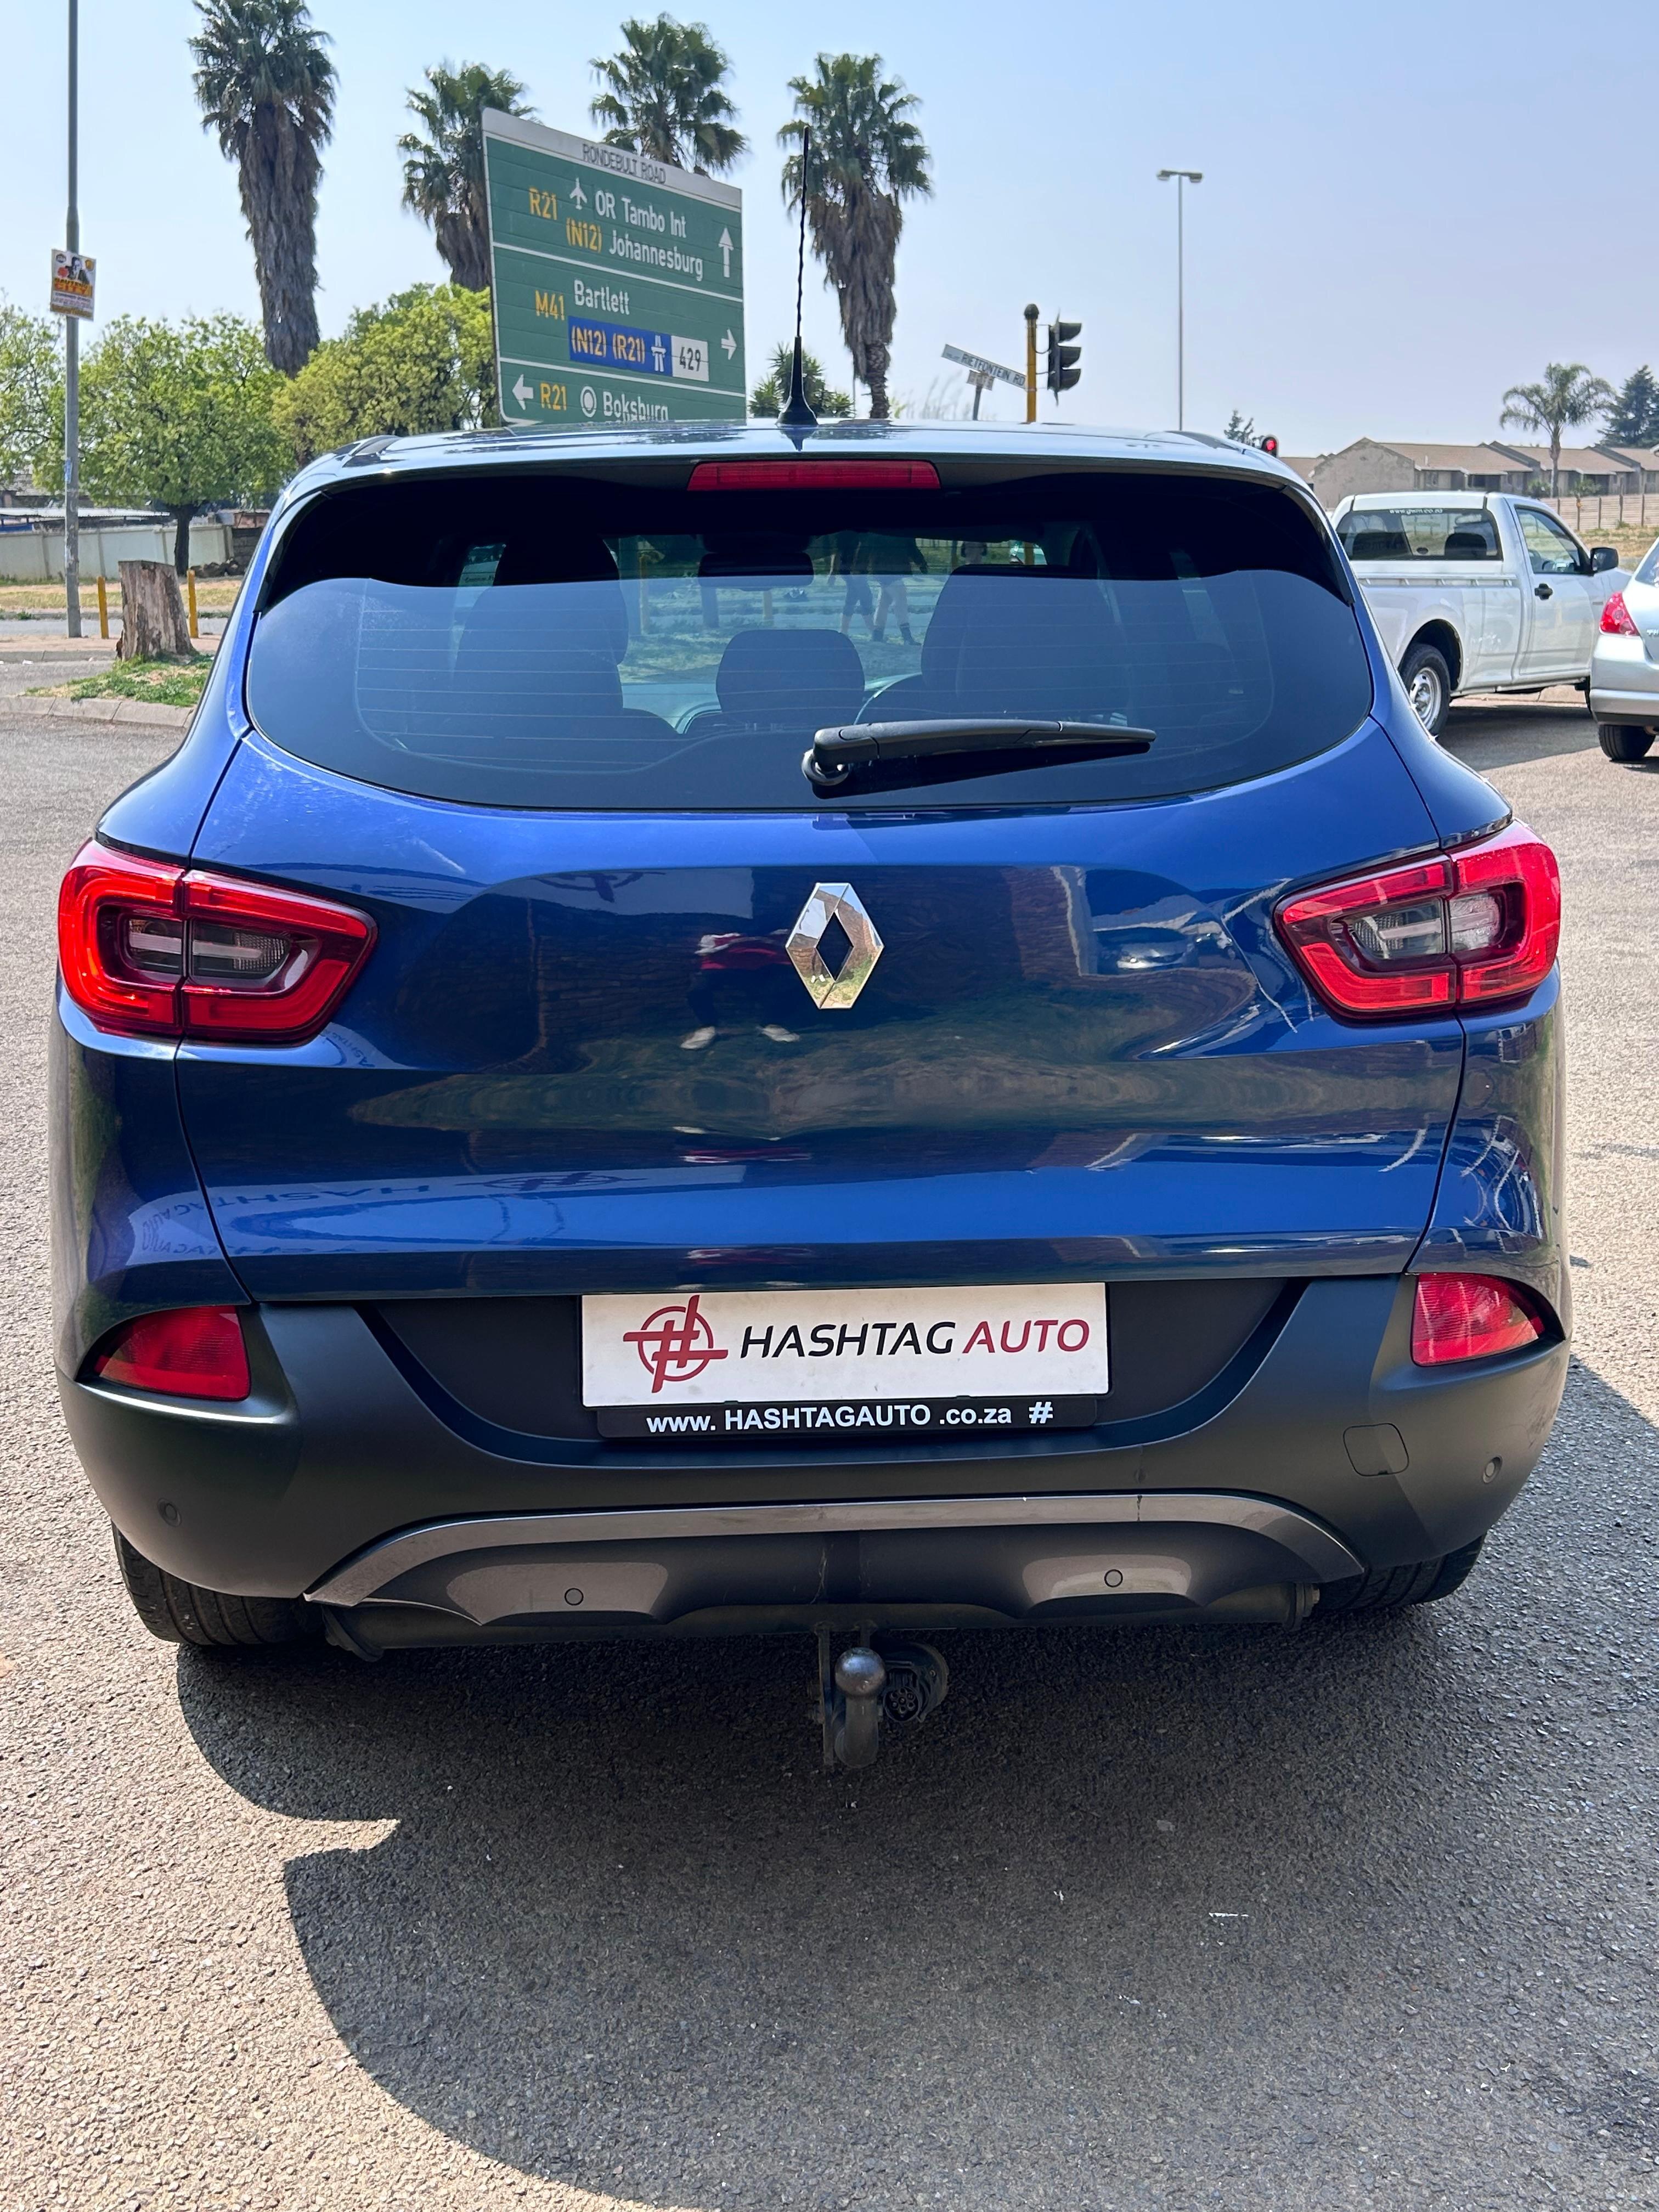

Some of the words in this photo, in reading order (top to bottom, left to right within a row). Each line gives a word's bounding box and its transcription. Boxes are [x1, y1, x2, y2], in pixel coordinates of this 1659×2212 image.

[582, 144, 637, 176] RONDEBULT
[641, 162, 667, 184] ROAD
[529, 186, 557, 221] R21
[595, 190, 617, 219] OR
[621, 196, 665, 233] Tambo
[670, 210, 687, 238] Int
[566, 217, 602, 253] (N12)
[608, 229, 703, 281] Johannesburg
[535, 289, 565, 321] M41
[574, 279, 630, 315] Bartlett
[571, 325, 607, 357] (N12)
[612, 332, 646, 364] (R21)
[679, 346, 702, 372] 429
[540, 382, 567, 411] R21
[740, 1321, 956, 1358] HASHTAG
[962, 1319, 1090, 1354] AUTO
[646, 1415, 716, 1433] www.
[725, 1404, 931, 1430] HASHTAGAUTO
[939, 1408, 1012, 1425] .co.za
